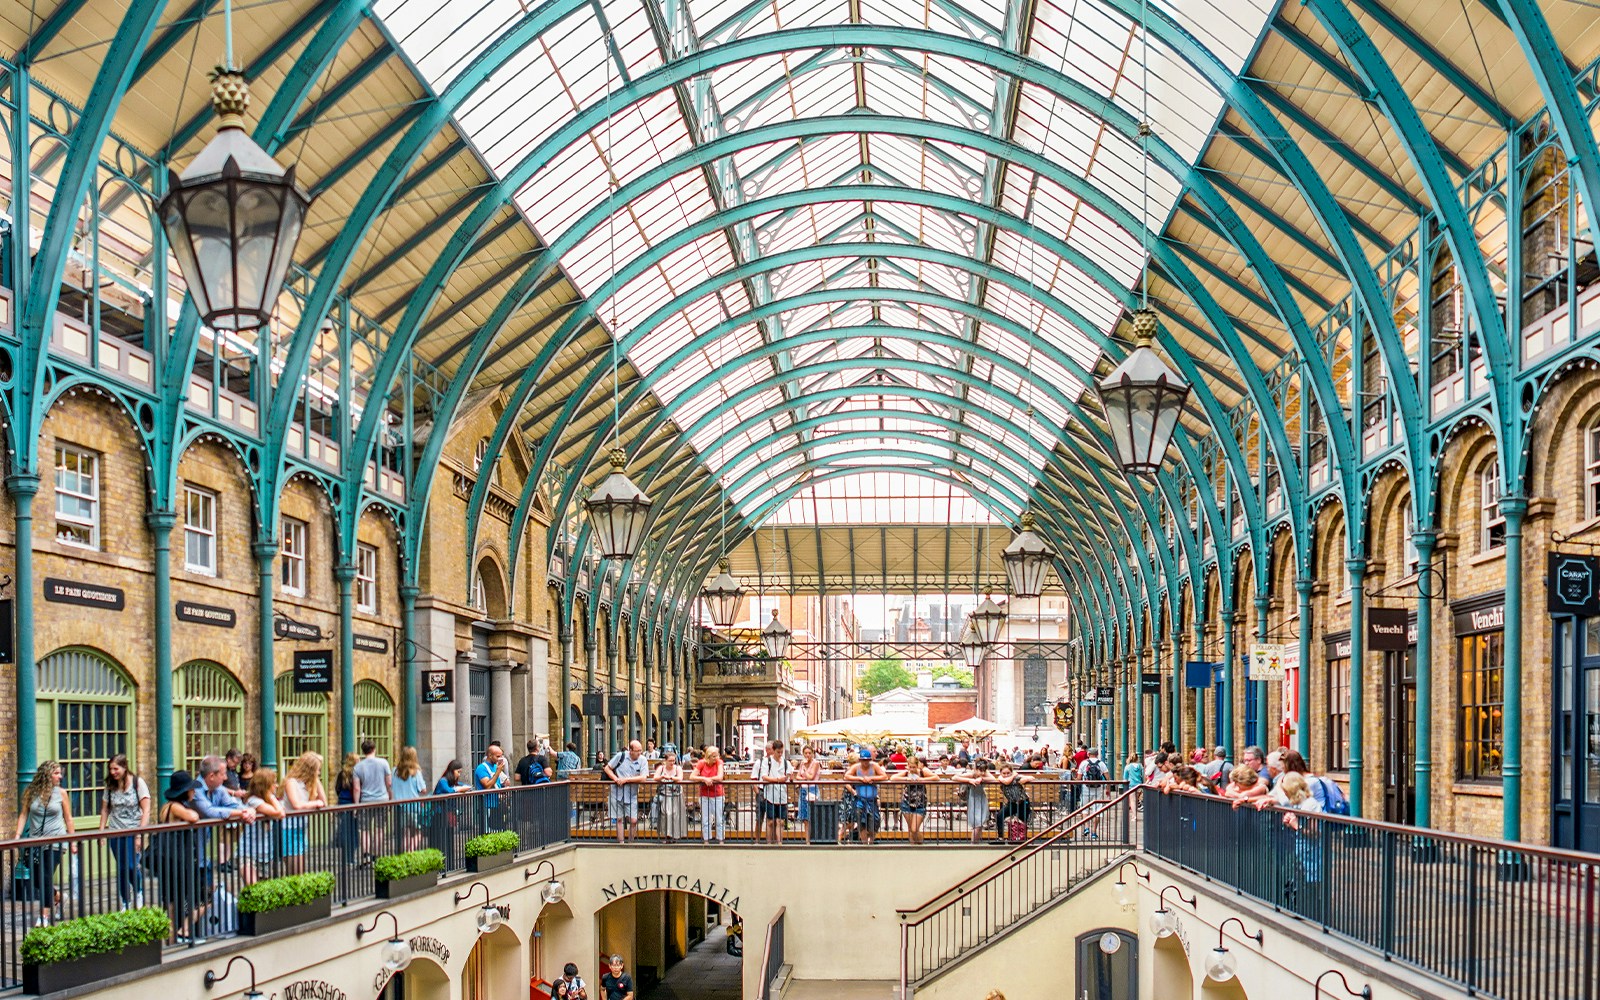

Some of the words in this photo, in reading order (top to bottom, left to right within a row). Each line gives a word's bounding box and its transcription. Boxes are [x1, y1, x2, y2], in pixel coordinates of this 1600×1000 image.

[54, 585, 64, 595] LE
[65, 587, 81, 597] PAIN
[1372, 624, 1404, 634] Venchi
[1471, 606, 1504, 630] Venchi
[601, 874, 741, 911] NAUTICALIA
[409, 936, 451, 965] WORKSHOP
